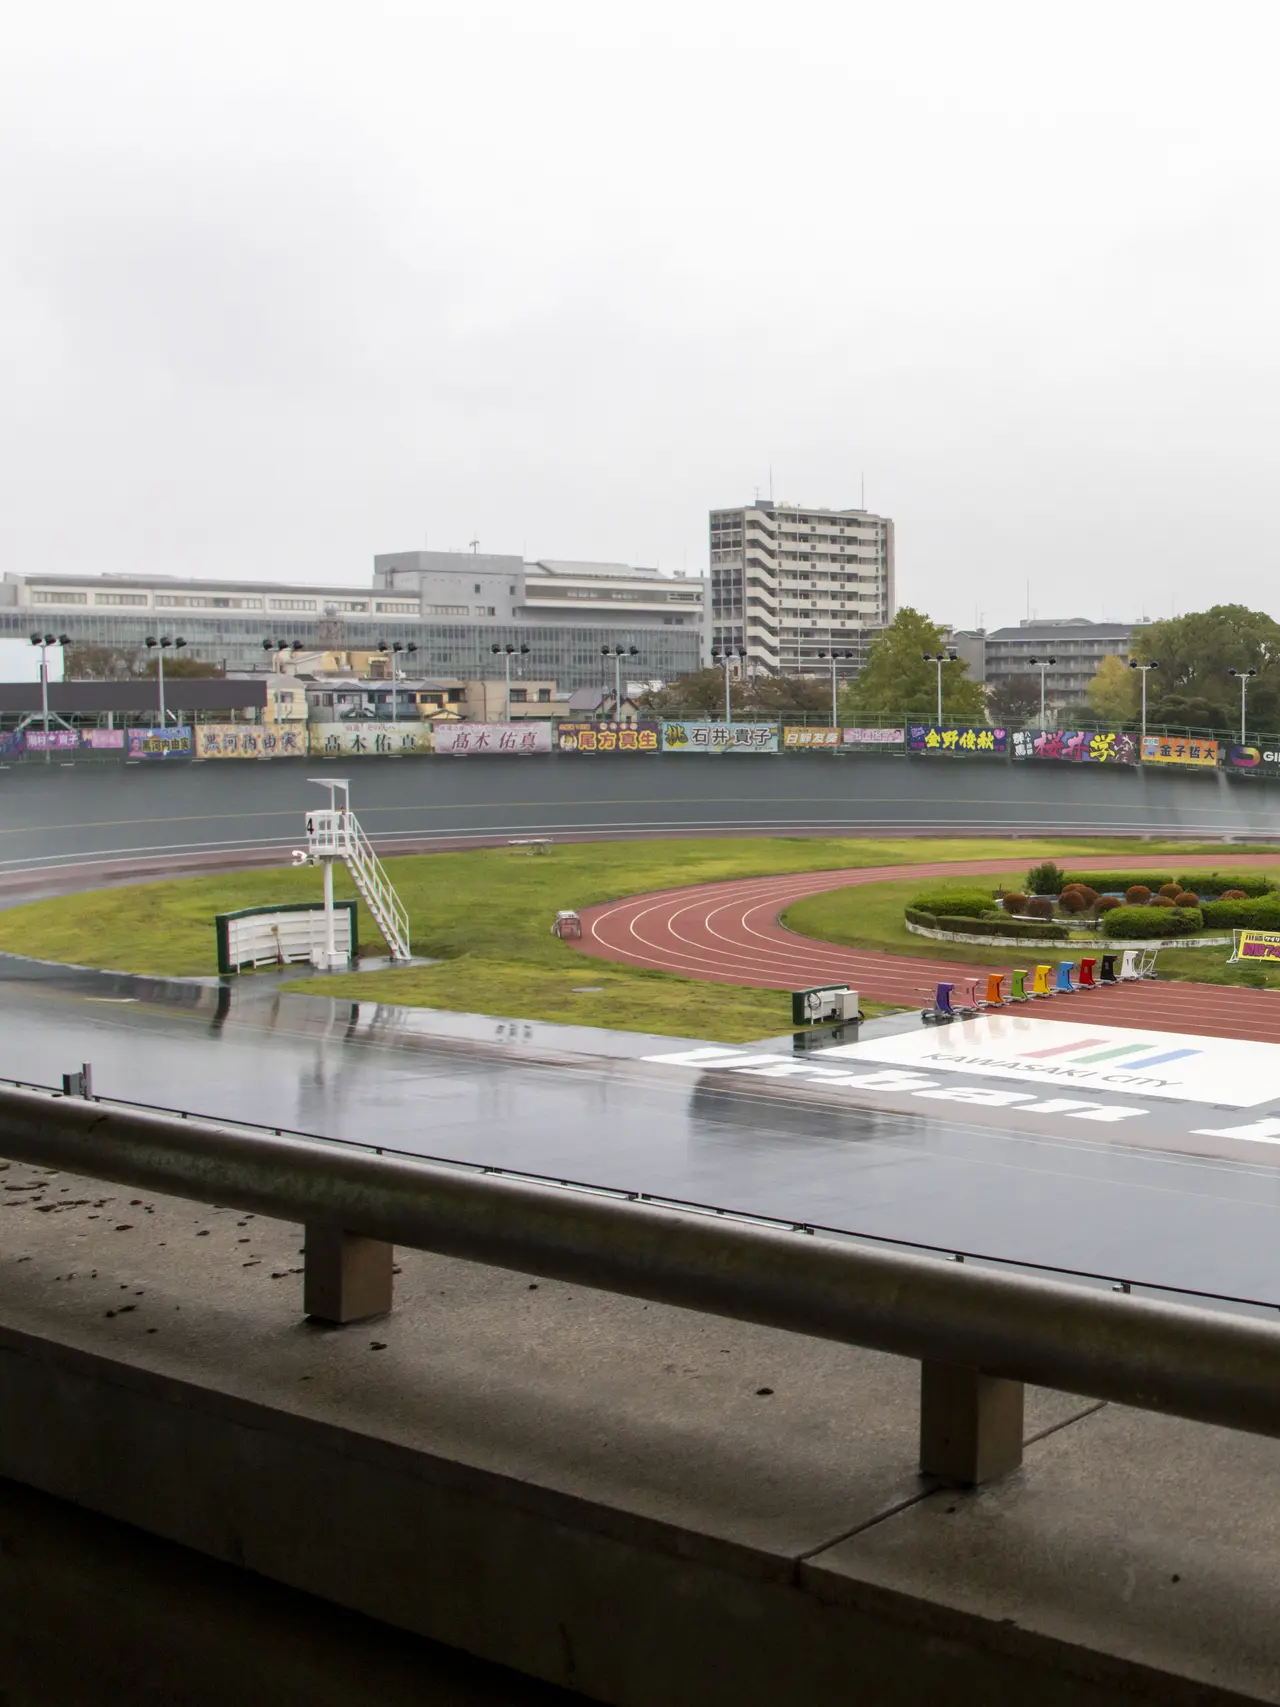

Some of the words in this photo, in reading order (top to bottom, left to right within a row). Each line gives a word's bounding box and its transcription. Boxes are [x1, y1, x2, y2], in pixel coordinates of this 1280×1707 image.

[205, 731, 297, 751] 黒河内由実
[578, 730, 657, 750] 尾方真生
[691, 725, 772, 745] 石井貴子
[1160, 744, 1215, 760] 金子哲大
[306, 818, 315, 835] 4
[920, 1052, 1098, 1077] KAWASAKI
[1100, 1074, 1183, 1088] CITY
[640, 1047, 1151, 1122] Urban
